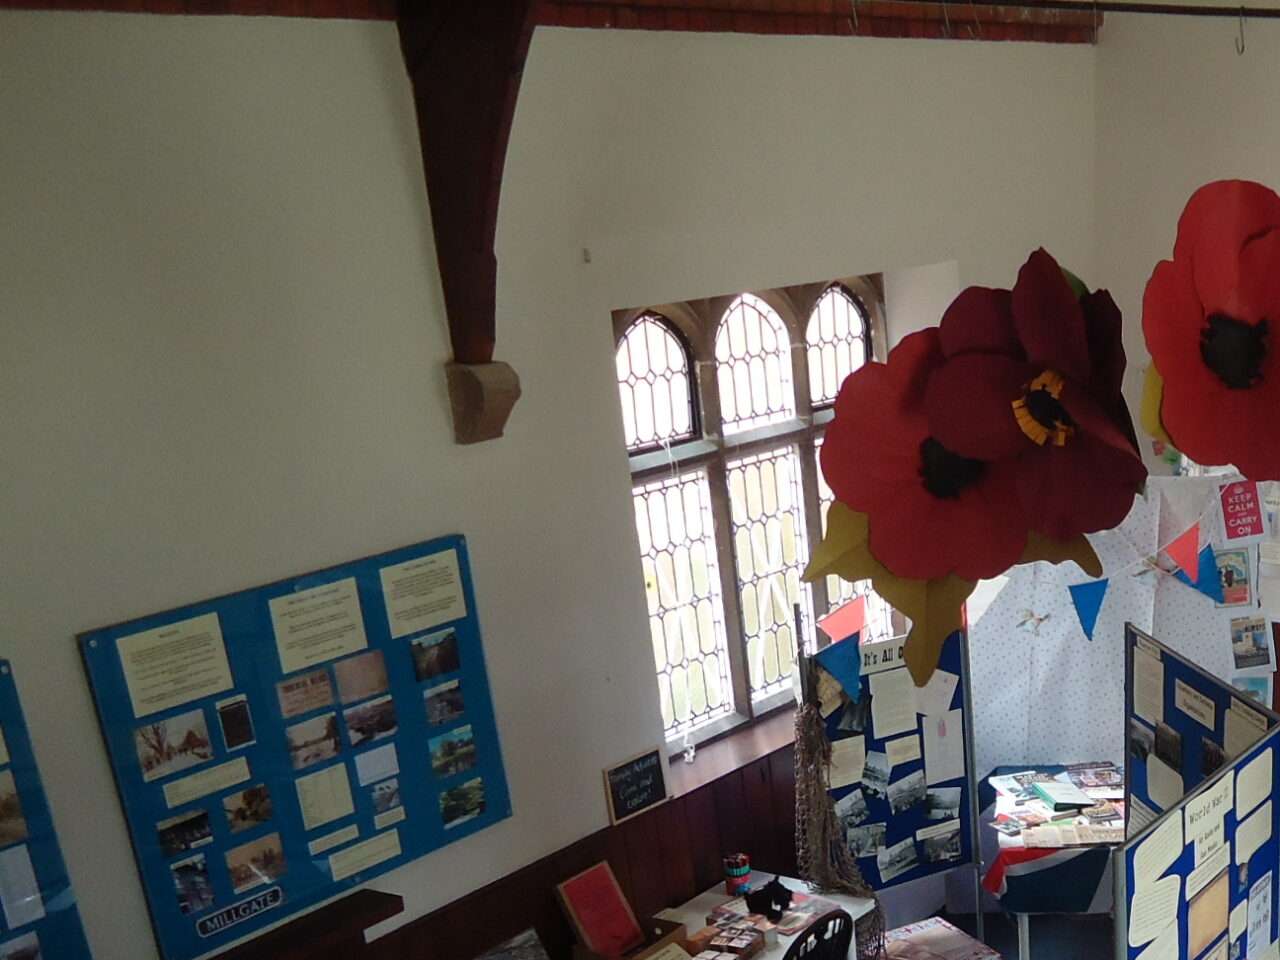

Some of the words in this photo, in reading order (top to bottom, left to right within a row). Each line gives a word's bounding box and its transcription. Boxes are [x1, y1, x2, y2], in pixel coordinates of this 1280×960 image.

[1229, 493, 1252, 503] KEEP
[1228, 501, 1254, 512] CALM
[1229, 516, 1257, 527] CARRY
[1238, 525, 1251, 535] ON
[864, 651, 878, 666] It's
[882, 647, 894, 662] All
[206, 892, 275, 933] MILLGATE
